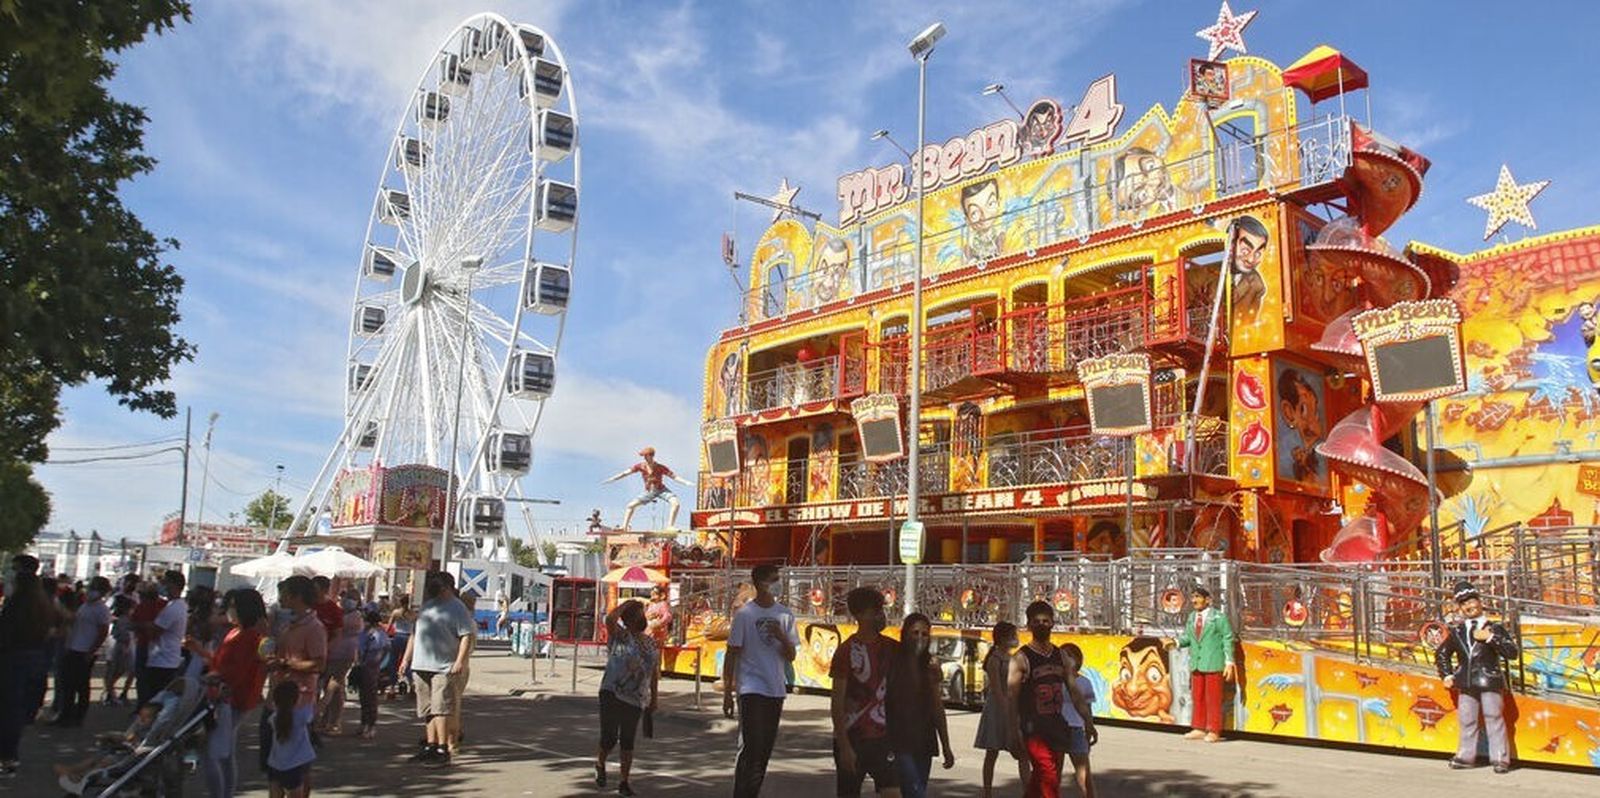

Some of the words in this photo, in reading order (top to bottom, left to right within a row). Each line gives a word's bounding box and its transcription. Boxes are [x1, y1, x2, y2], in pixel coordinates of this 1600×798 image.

[838, 163, 909, 229] Mr.
[909, 118, 1023, 193] Bean
[1060, 72, 1126, 146] 4
[765, 508, 785, 521] EL
[787, 503, 853, 521] SHOW
[856, 501, 885, 517] DE
[942, 491, 1015, 512] BEAN
[1021, 489, 1045, 507] 4
